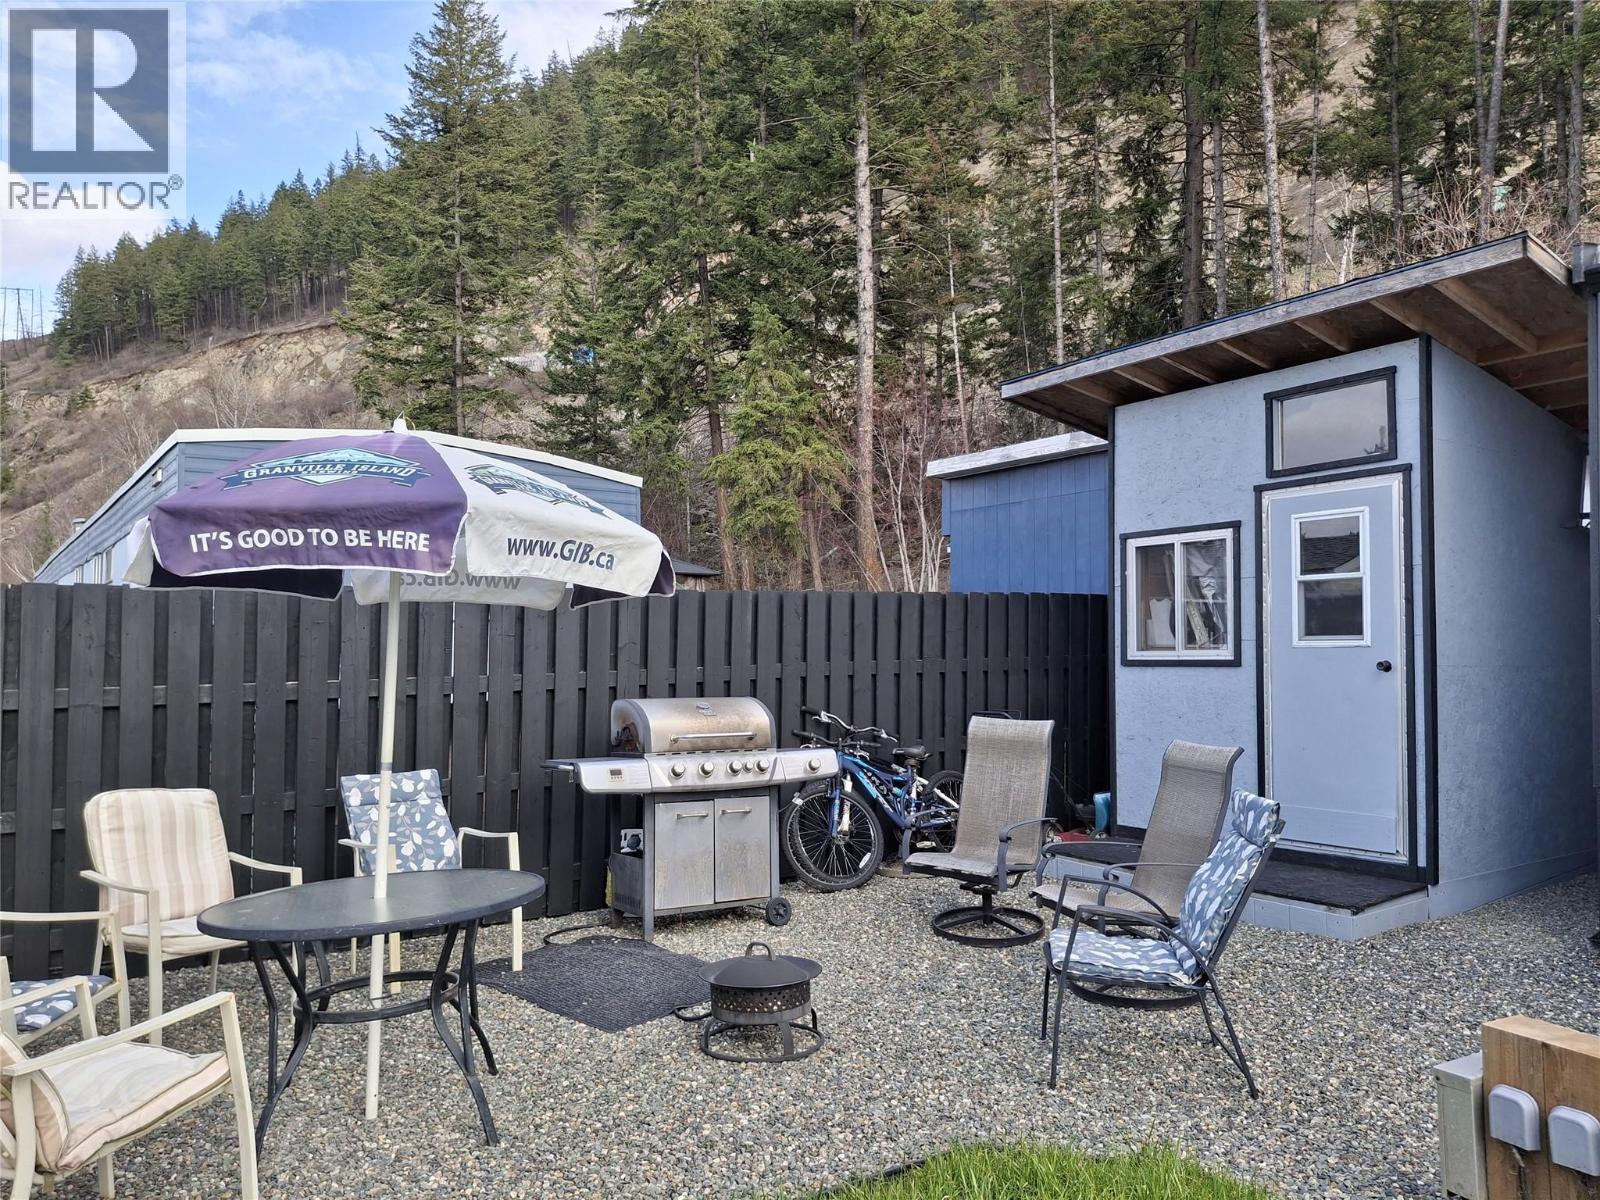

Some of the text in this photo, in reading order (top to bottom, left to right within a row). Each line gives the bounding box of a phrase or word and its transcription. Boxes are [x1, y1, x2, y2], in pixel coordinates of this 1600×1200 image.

[243, 463, 416, 479] GRANVILLE ISLAND
[189, 528, 430, 553] IT'S GOOD TO BE HERE
